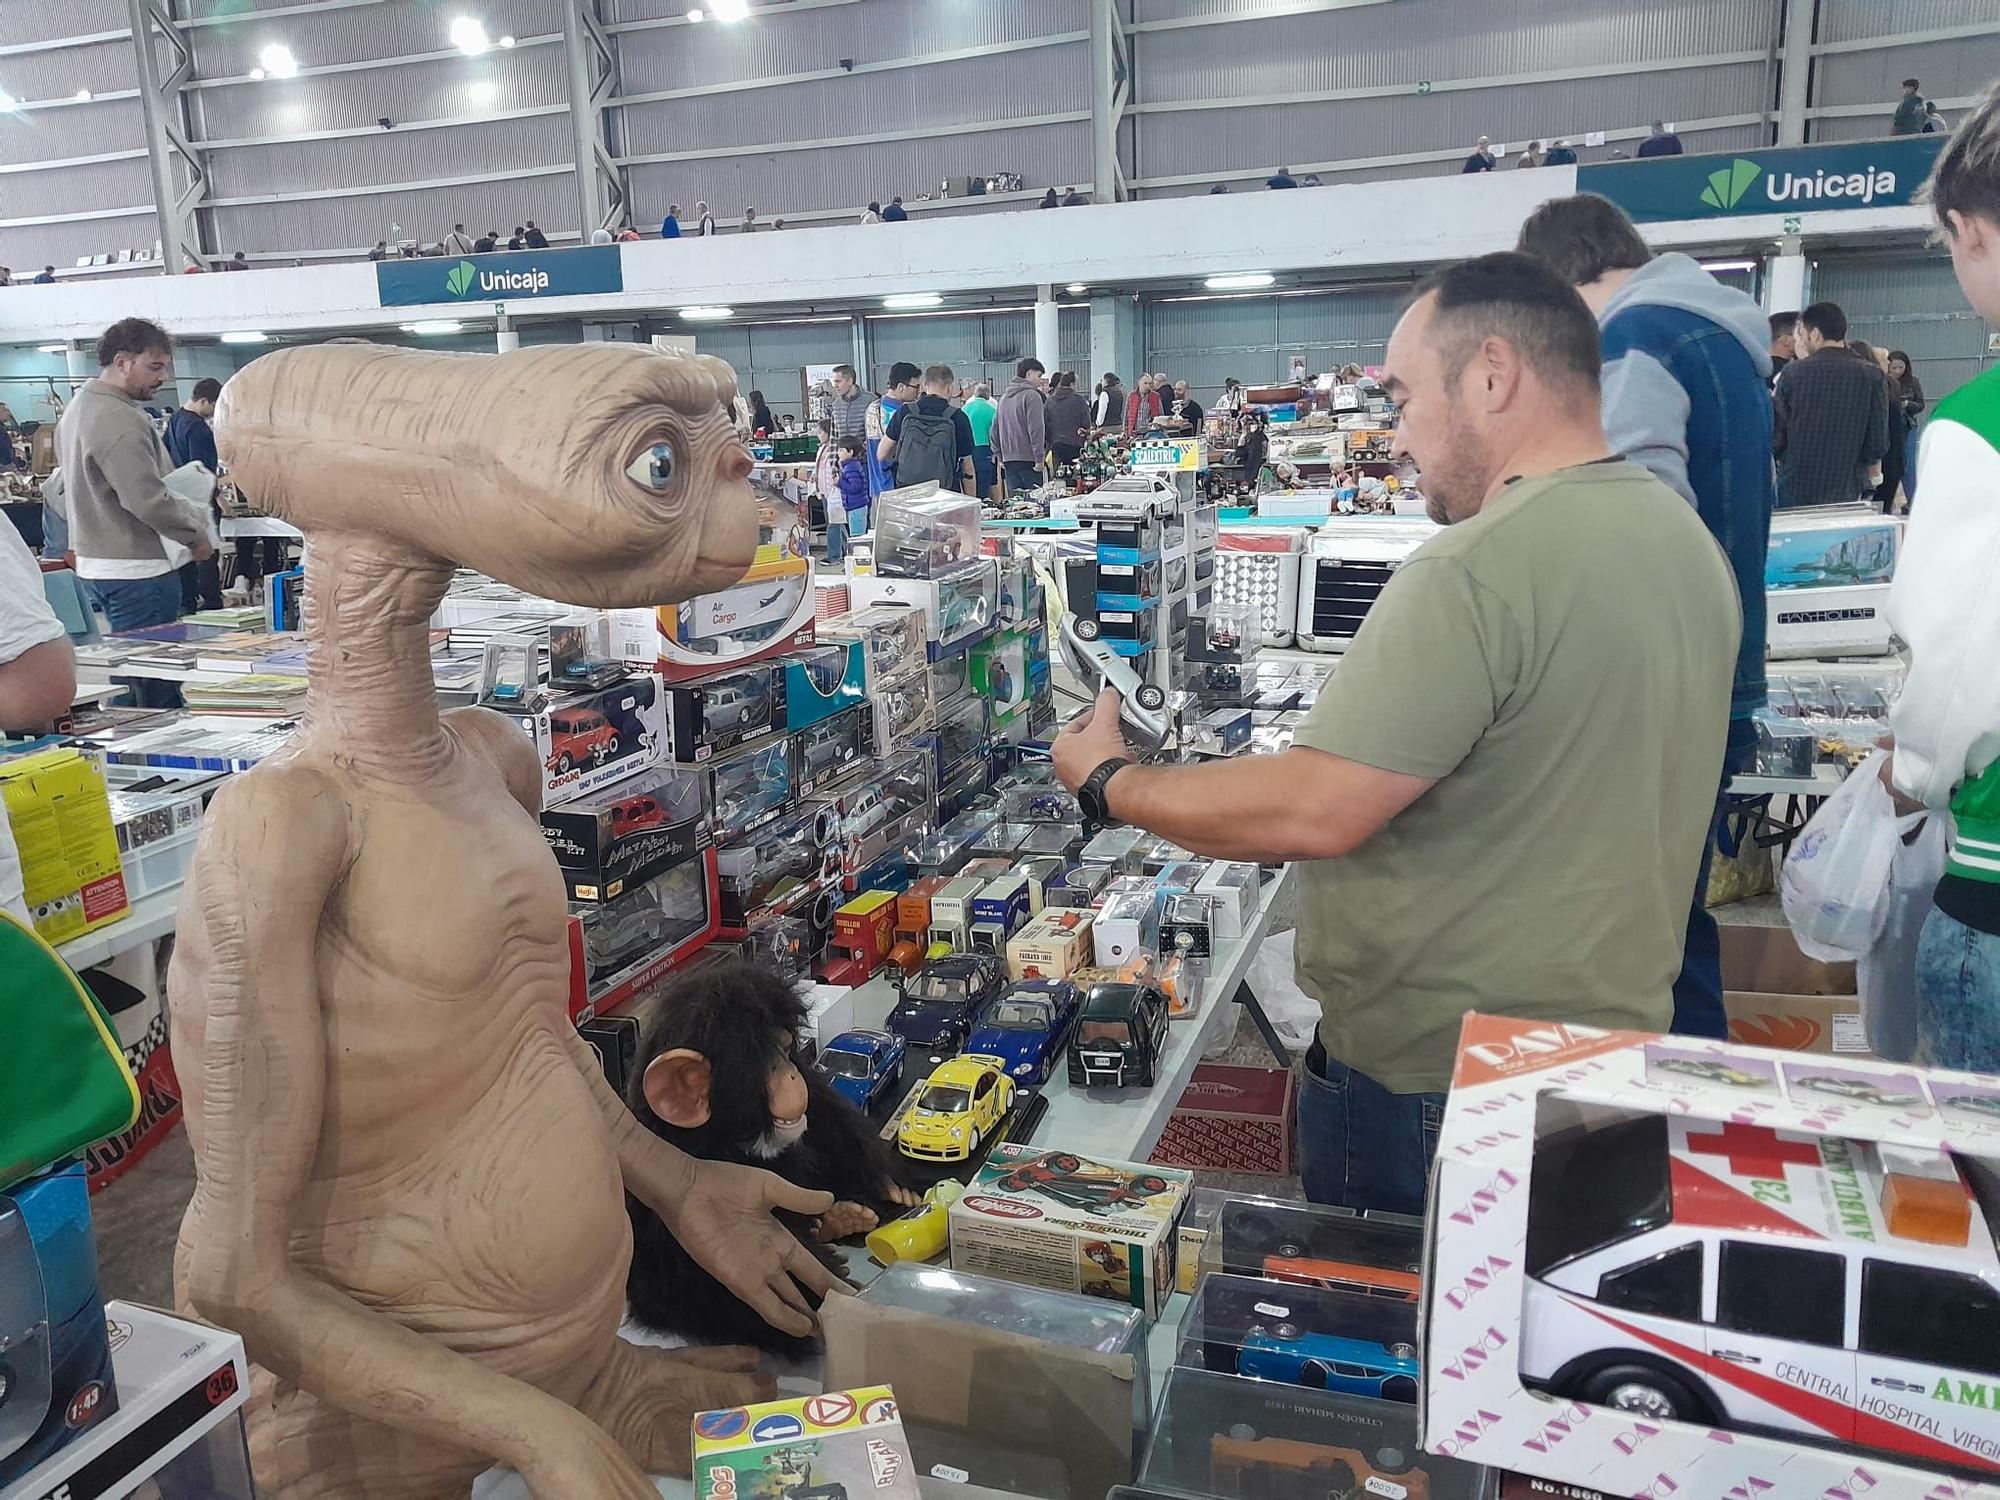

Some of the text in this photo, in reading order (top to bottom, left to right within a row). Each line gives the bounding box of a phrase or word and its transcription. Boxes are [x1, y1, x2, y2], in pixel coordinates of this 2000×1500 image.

[1766, 165, 1896, 203] Unicaja
[479, 267, 549, 293] Unicaja
[1135, 448, 1176, 464] SCALEXTRIC
[712, 602, 724, 612] Air
[712, 612, 737, 625] Cargo
[794, 633, 814, 645] METAL
[741, 725, 772, 741] GOLDFINGER
[651, 954, 676, 977] EDITION
[1169, 1121, 1190, 1136] VANS
[1186, 1116, 1209, 1133] VANS
[1246, 1124, 1270, 1141] VANS
[1193, 1131, 1217, 1149] VANS
[1211, 1129, 1234, 1146] VANS
[1228, 1126, 1252, 1143] VANS
[1159, 1140, 1182, 1154] VANS
[1176, 1135, 1200, 1152] VANS
[1236, 1142, 1260, 1159] VANS
[1254, 1139, 1279, 1156] VANS
[1201, 1147, 1226, 1165] VANS
[1218, 1144, 1243, 1162] VANS
[1750, 1180, 1793, 1205] 23
[1042, 1216, 1084, 1229] COBRA
[1084, 1221, 1149, 1238] THUNDER
[209, 1369, 235, 1399] 36
[70, 1386, 100, 1421] 1:43
[1775, 1361, 1852, 1404] CENTRAL
[1860, 1394, 1944, 1438] HOSPITAL
[1294, 1405, 1335, 1419] MEHARI
[1336, 1413, 1384, 1428] CITROËN
